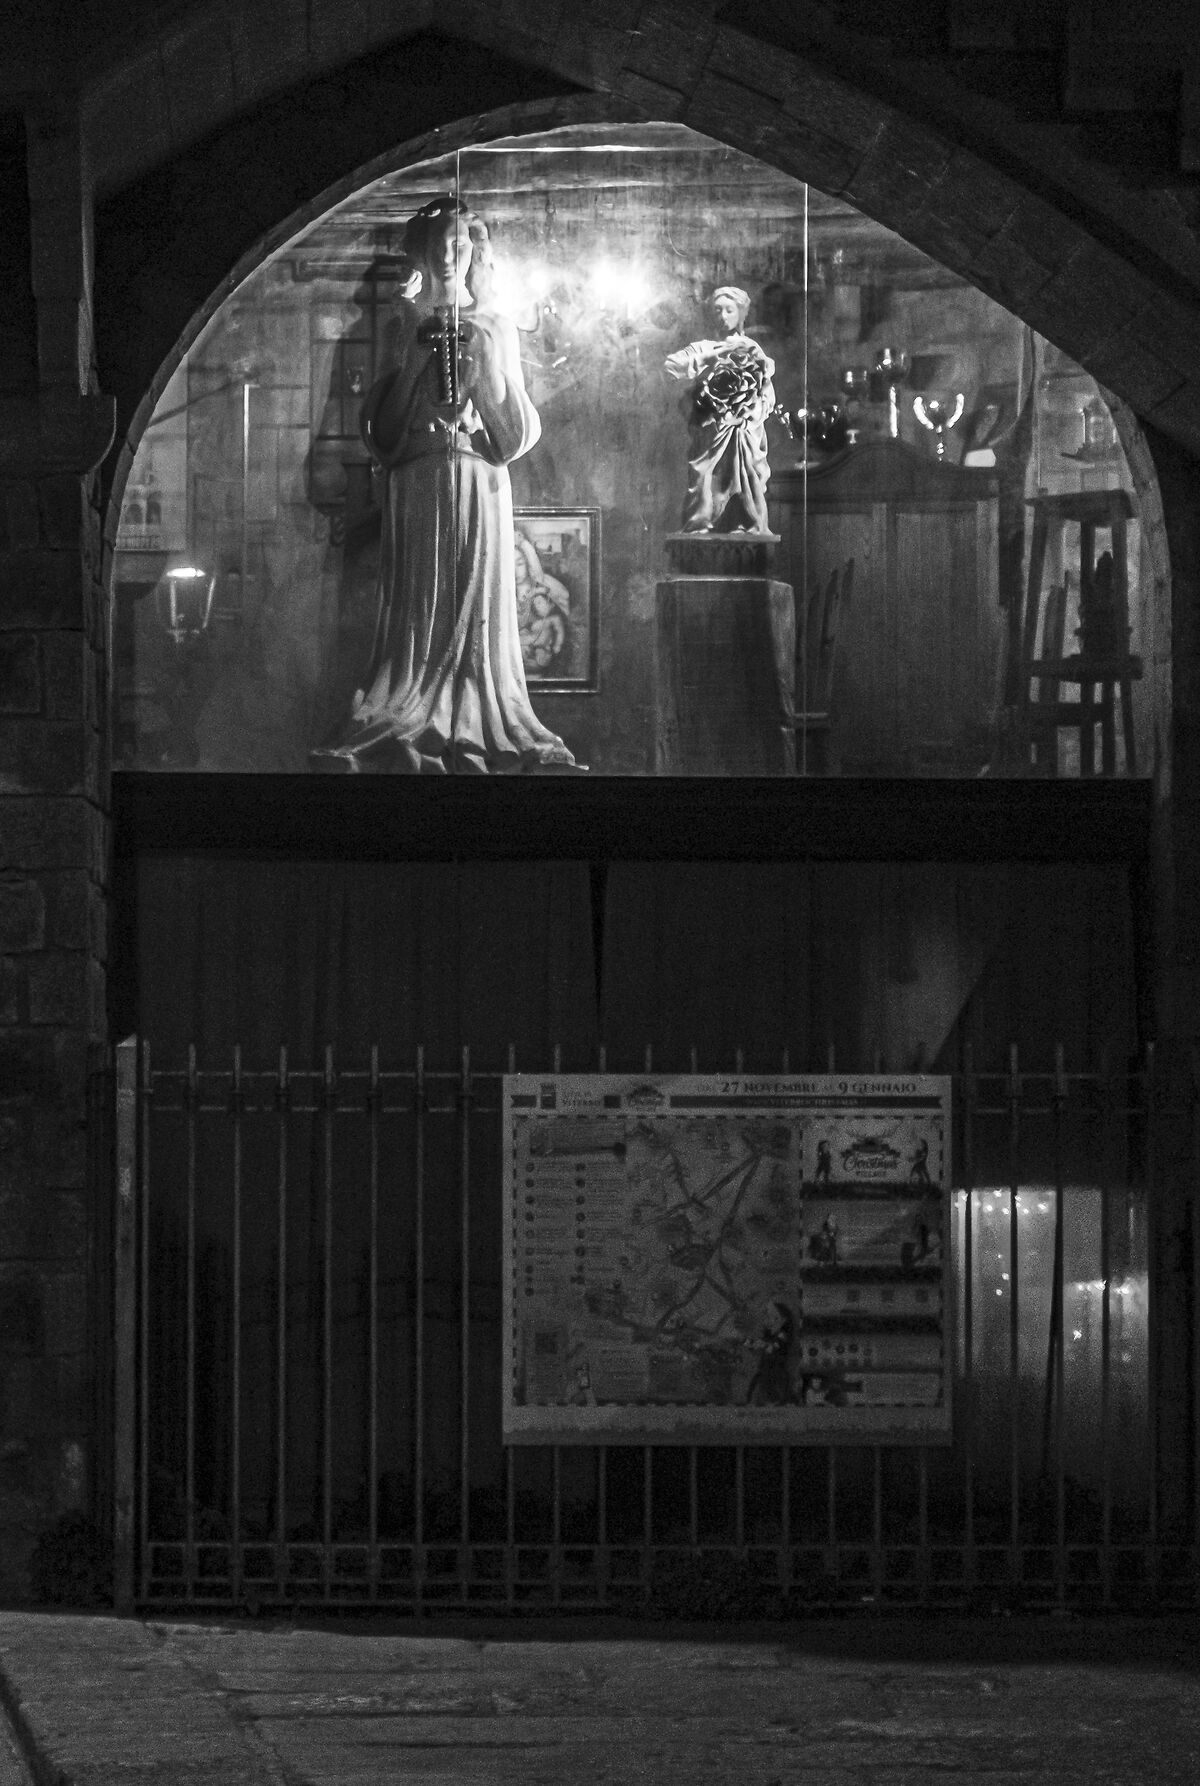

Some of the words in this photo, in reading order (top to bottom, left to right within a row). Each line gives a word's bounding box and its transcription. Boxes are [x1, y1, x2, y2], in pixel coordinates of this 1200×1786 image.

[721, 1082, 739, 1095] 27
[744, 1082, 816, 1093] NOVEMBRE
[838, 1082, 849, 1095] 9
[852, 1082, 917, 1095] GENNAIO
